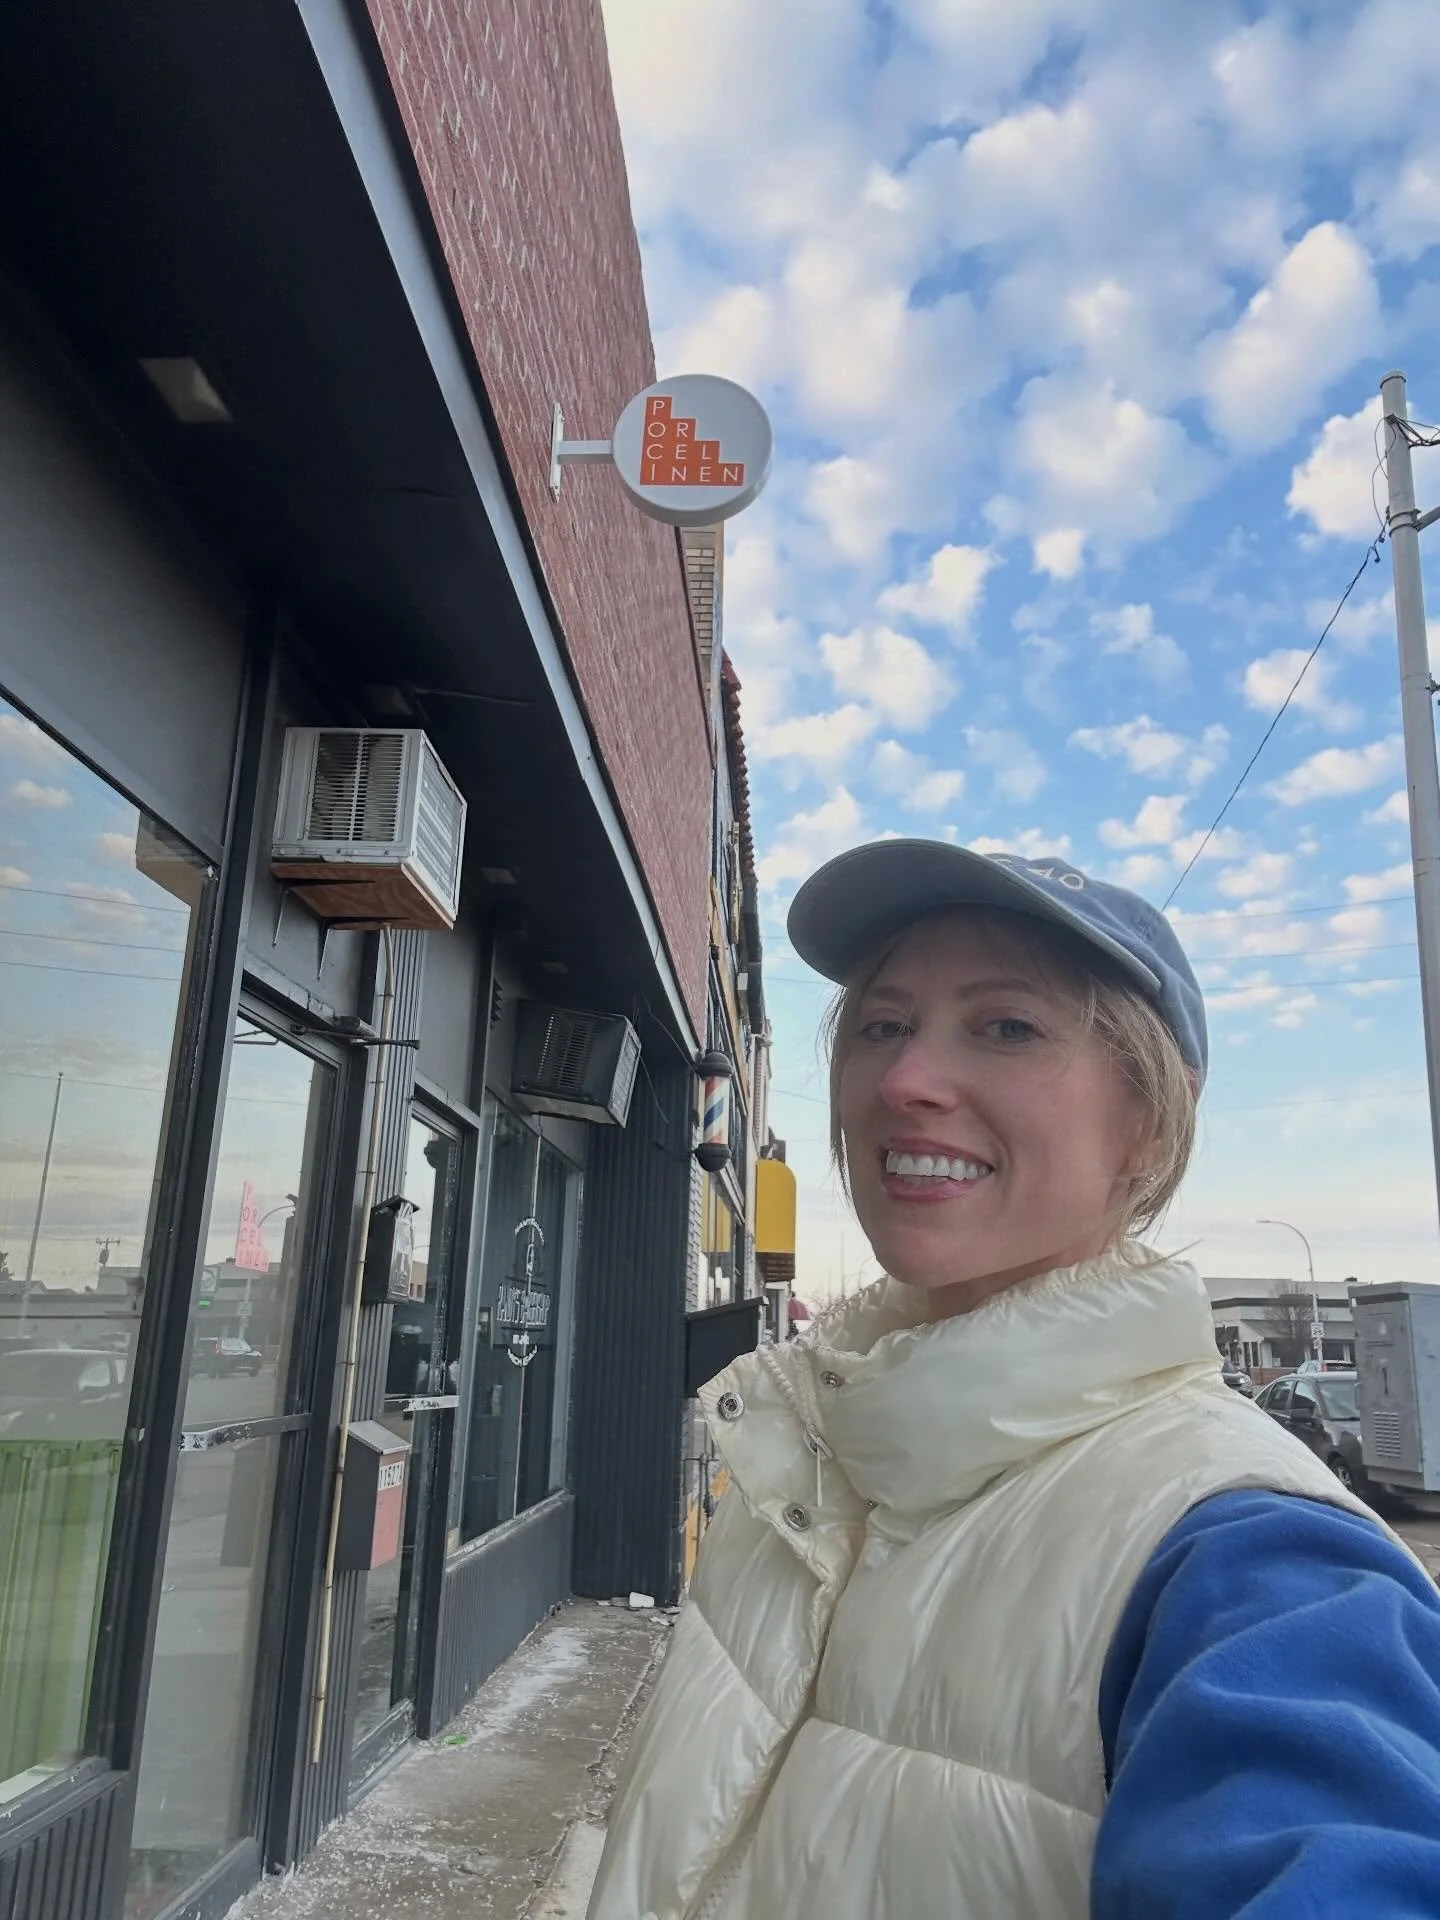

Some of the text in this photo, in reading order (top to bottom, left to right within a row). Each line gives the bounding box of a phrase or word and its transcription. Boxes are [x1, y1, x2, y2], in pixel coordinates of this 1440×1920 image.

[652, 400, 665, 416] P
[647, 422, 688, 438] OR
[646, 444, 712, 460] CEL
[650, 463, 739, 482] INEN
